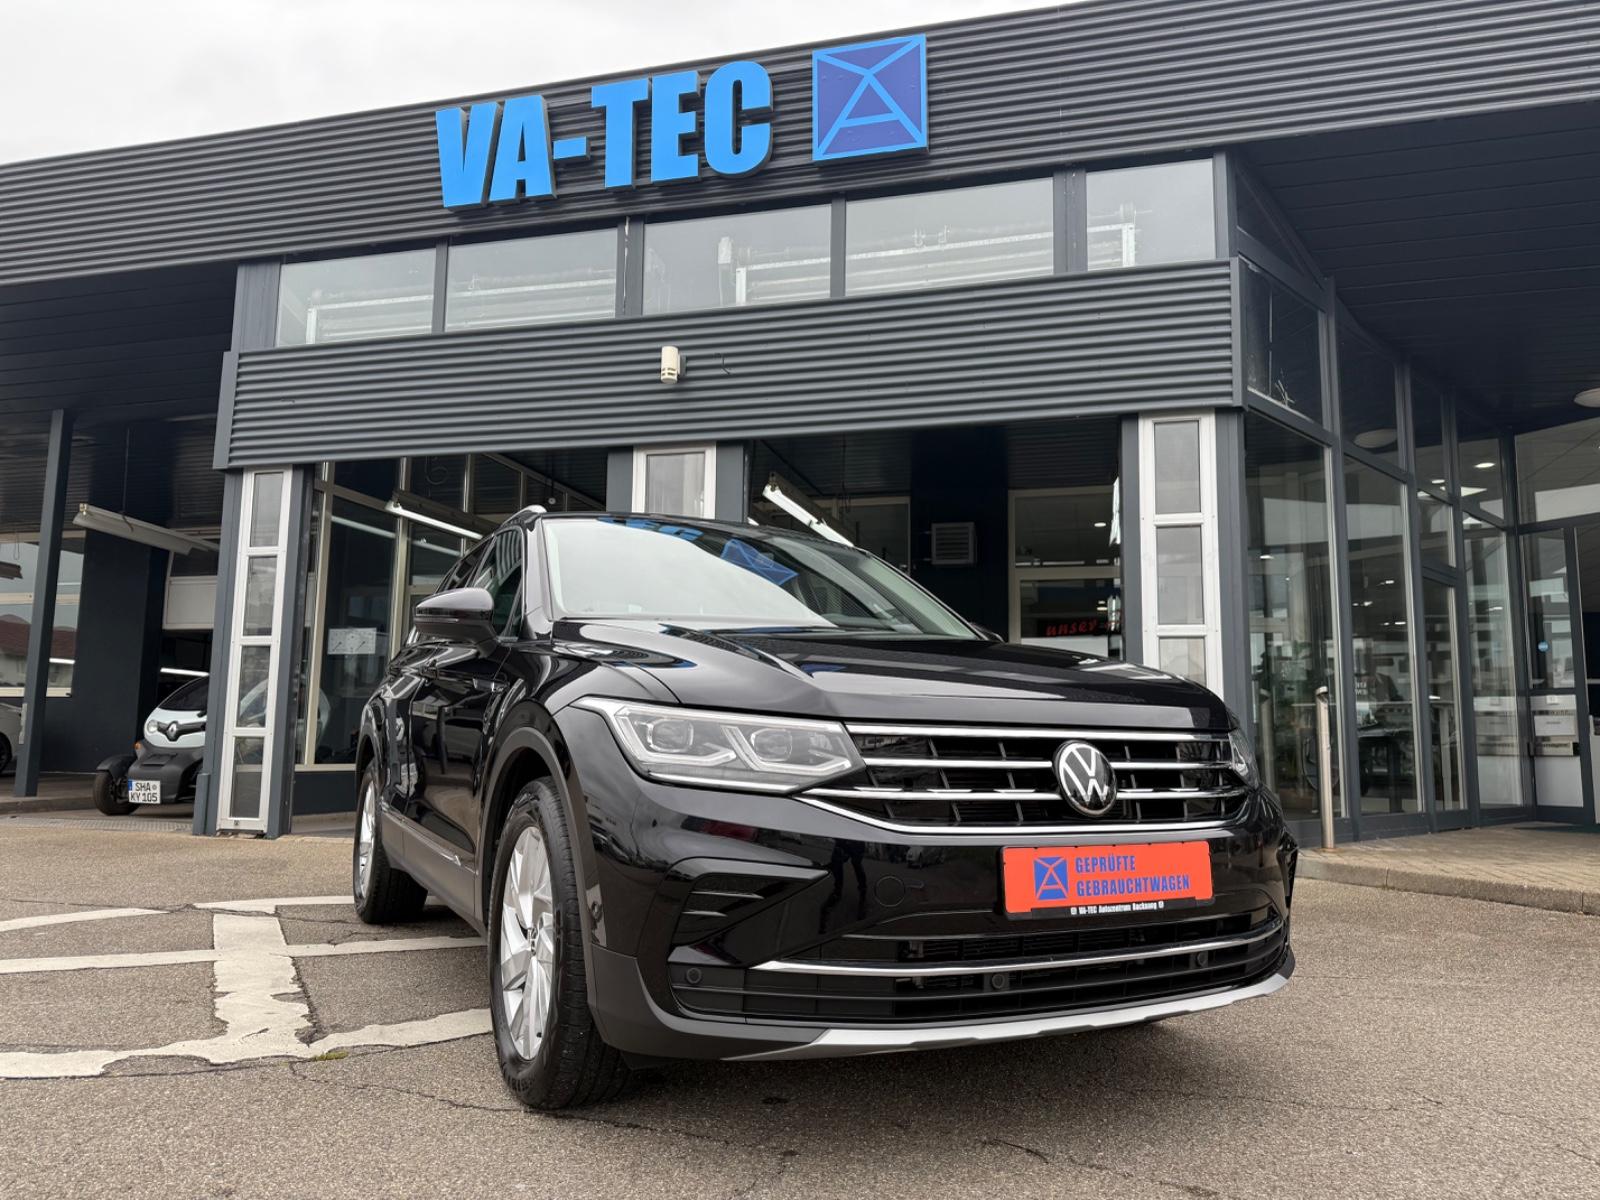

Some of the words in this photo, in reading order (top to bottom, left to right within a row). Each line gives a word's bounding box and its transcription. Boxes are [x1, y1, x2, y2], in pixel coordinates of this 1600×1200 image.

[435, 61, 773, 209] VA-TEC
[135, 782, 151, 792] SHA
[1075, 854, 1136, 873] GEPRÜFTE
[1076, 875, 1190, 897] GEBRAUCHTWAGEN
